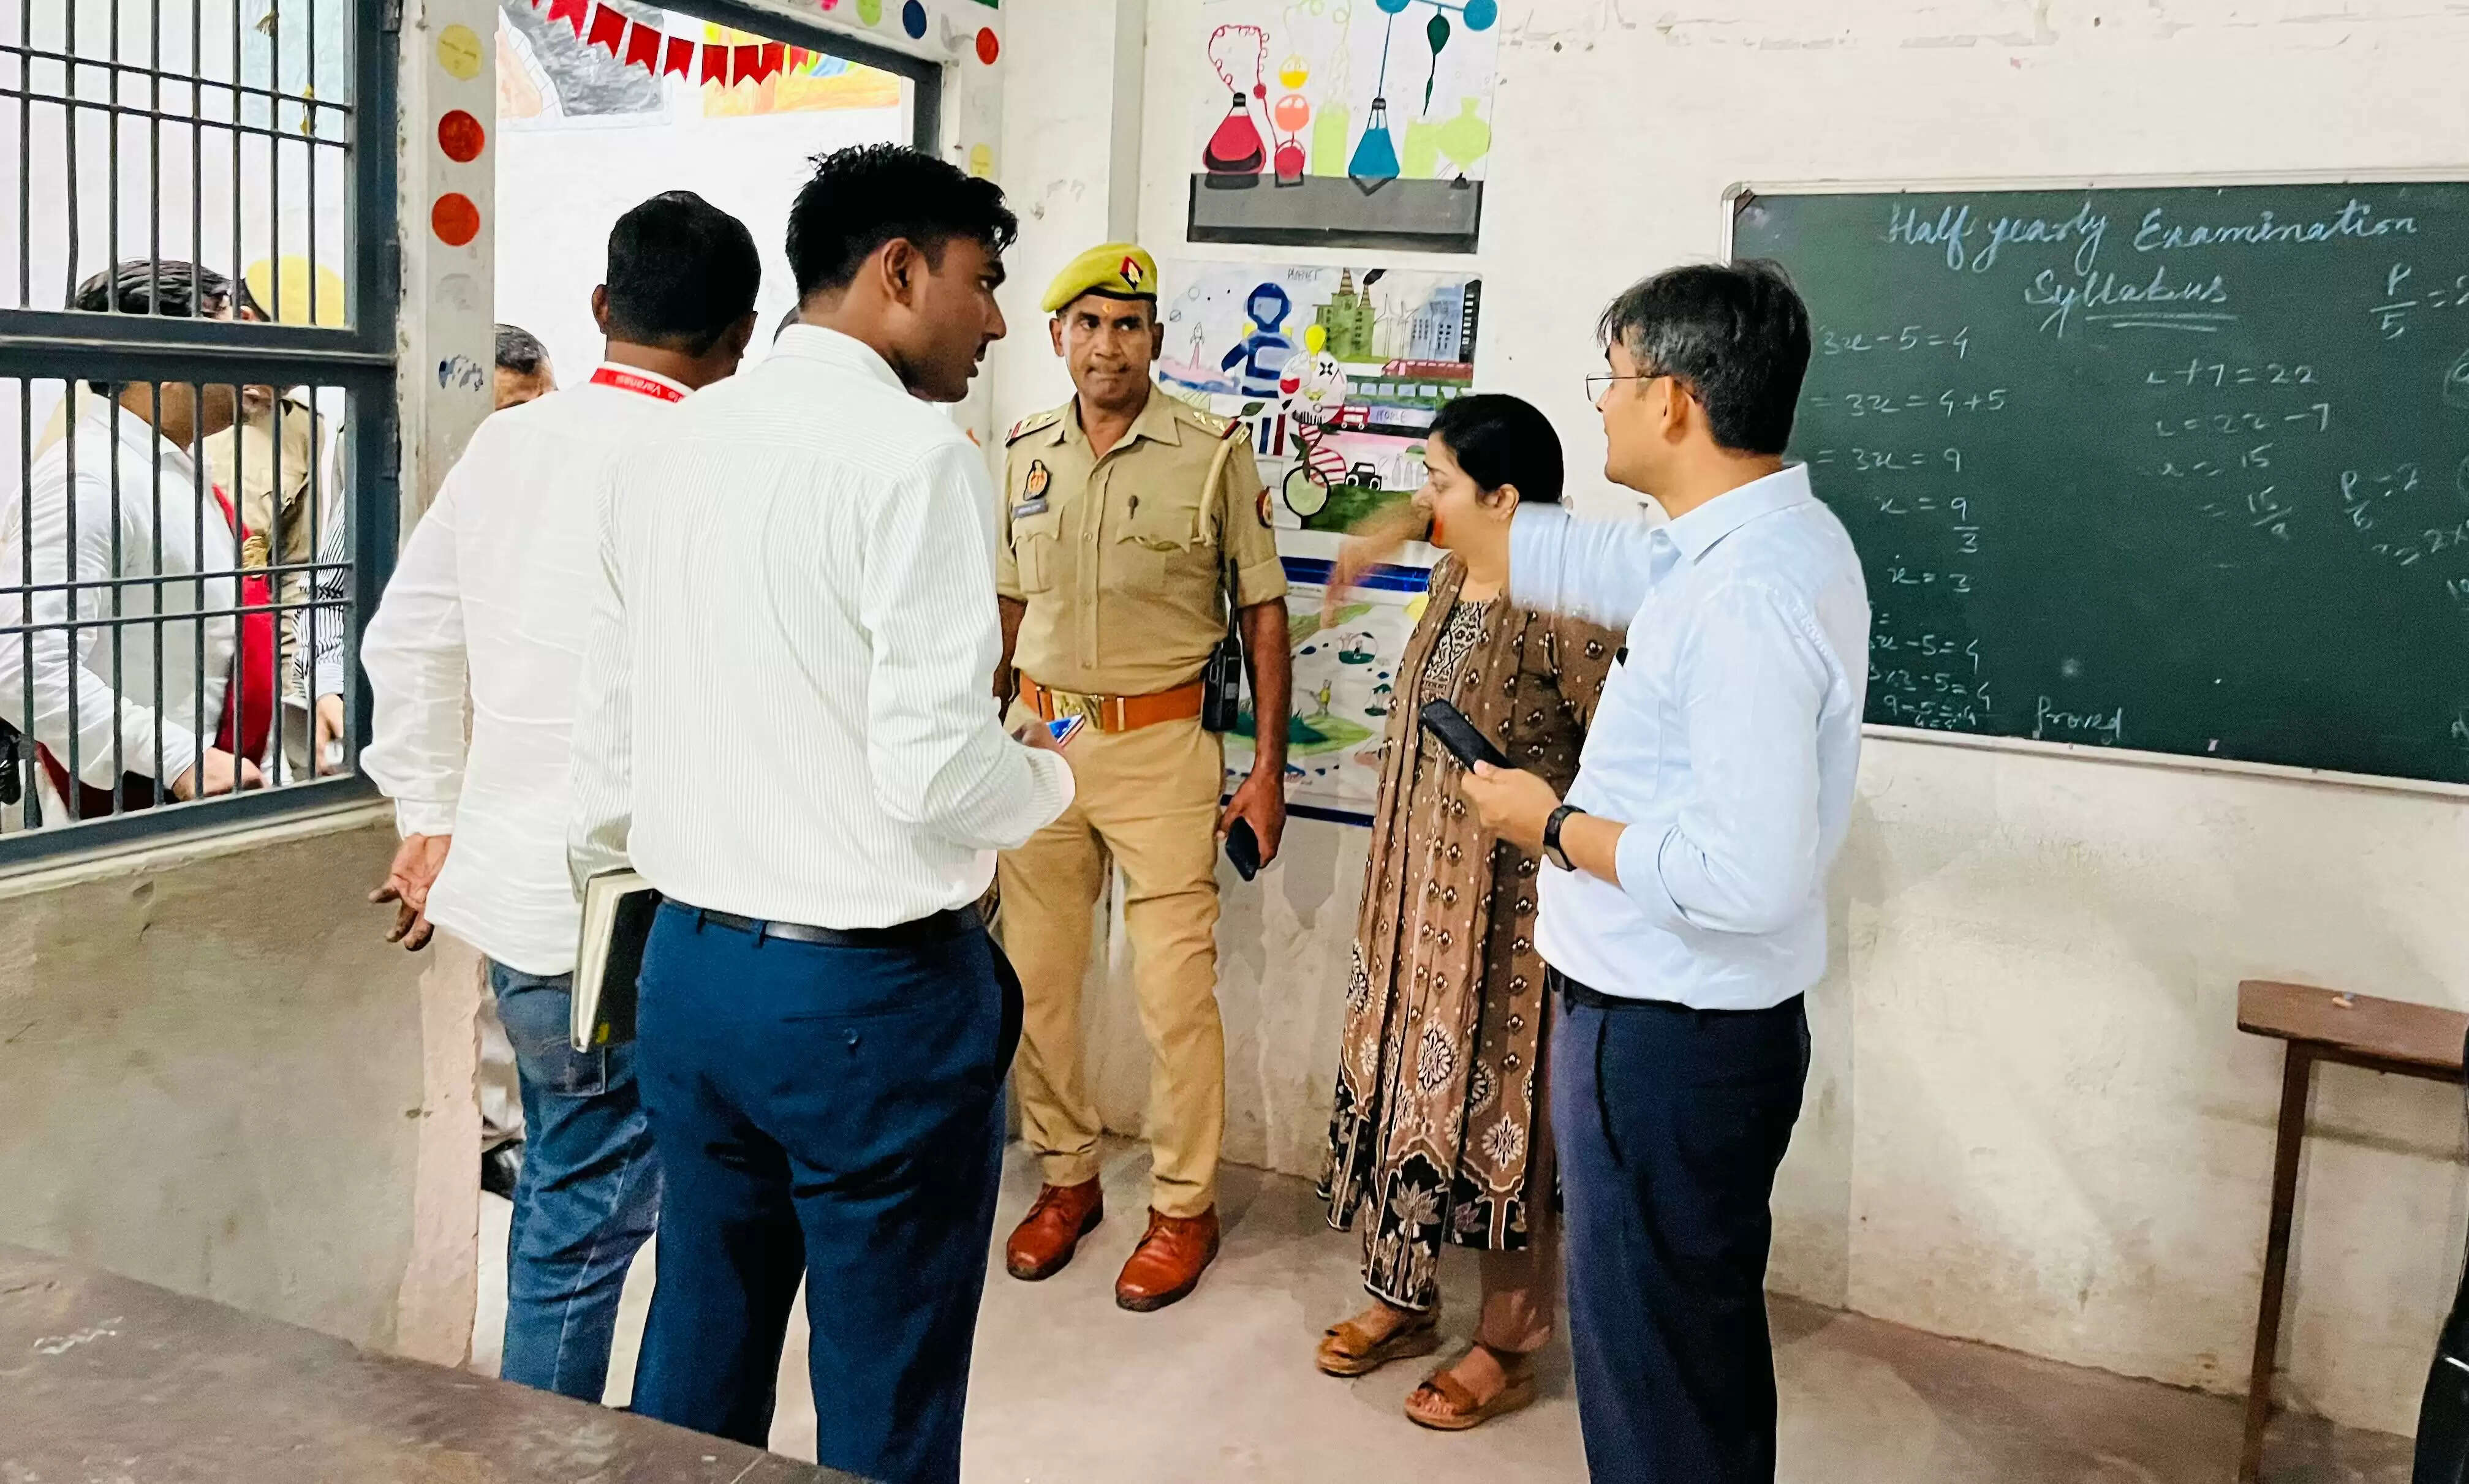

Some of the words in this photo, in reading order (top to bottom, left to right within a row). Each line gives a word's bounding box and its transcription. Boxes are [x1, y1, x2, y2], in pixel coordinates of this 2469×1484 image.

[1886, 203, 1976, 271] Half
[1972, 201, 2107, 276] yearly
[2133, 198, 2418, 252] Examination
